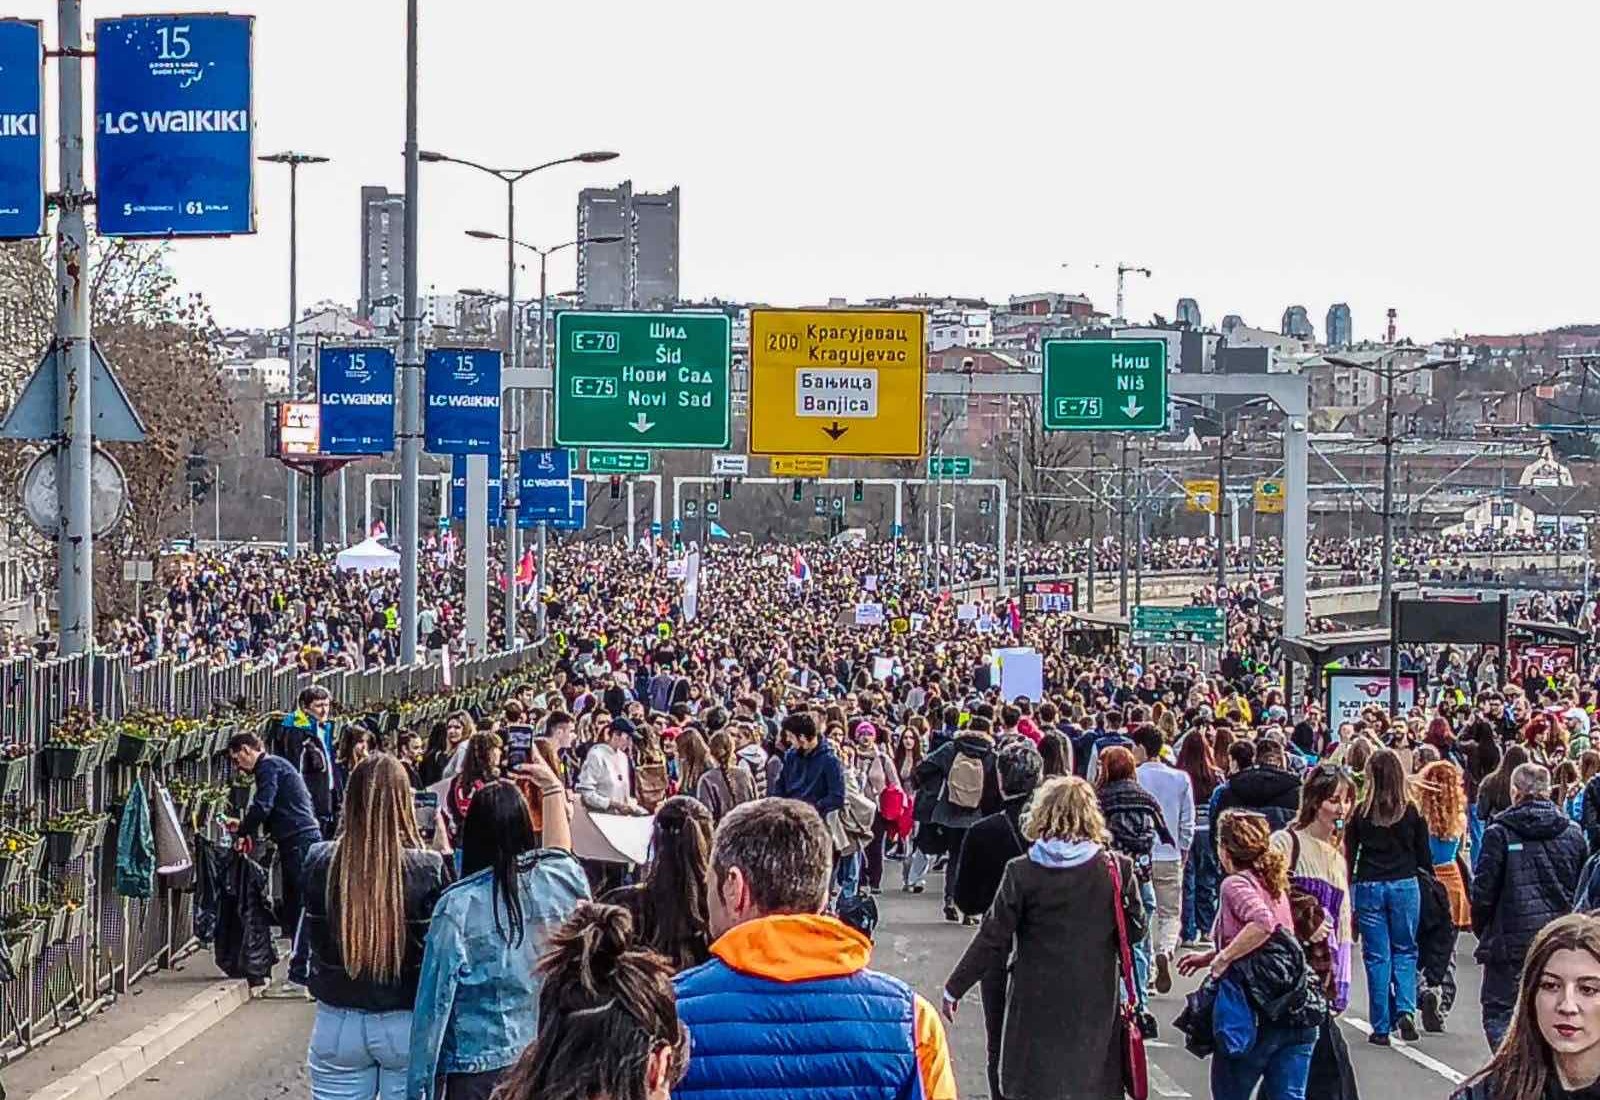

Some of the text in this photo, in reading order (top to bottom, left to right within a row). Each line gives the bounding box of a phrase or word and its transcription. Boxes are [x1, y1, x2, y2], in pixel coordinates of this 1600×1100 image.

[156, 26, 190, 59] 15
[105, 112, 139, 134] LC
[650, 323, 687, 339] Шид
[807, 324, 908, 344] Крагујевац
[575, 334, 615, 350] E-70
[769, 333, 799, 350] 200
[349, 354, 366, 370] 15
[655, 344, 682, 364] Šid
[808, 345, 906, 366] Kragujevac
[1112, 353, 1150, 369] Ниш
[456, 356, 474, 372] 15
[622, 366, 713, 383] Нови Сад
[802, 373, 872, 391] Бањица
[1117, 375, 1145, 390] Niš
[575, 379, 614, 395] E-75
[323, 393, 340, 405] LC
[429, 395, 447, 406] LC
[628, 390, 712, 407] Novi Sad
[804, 396, 869, 415] Banjica
[1059, 400, 1098, 415] E-75
